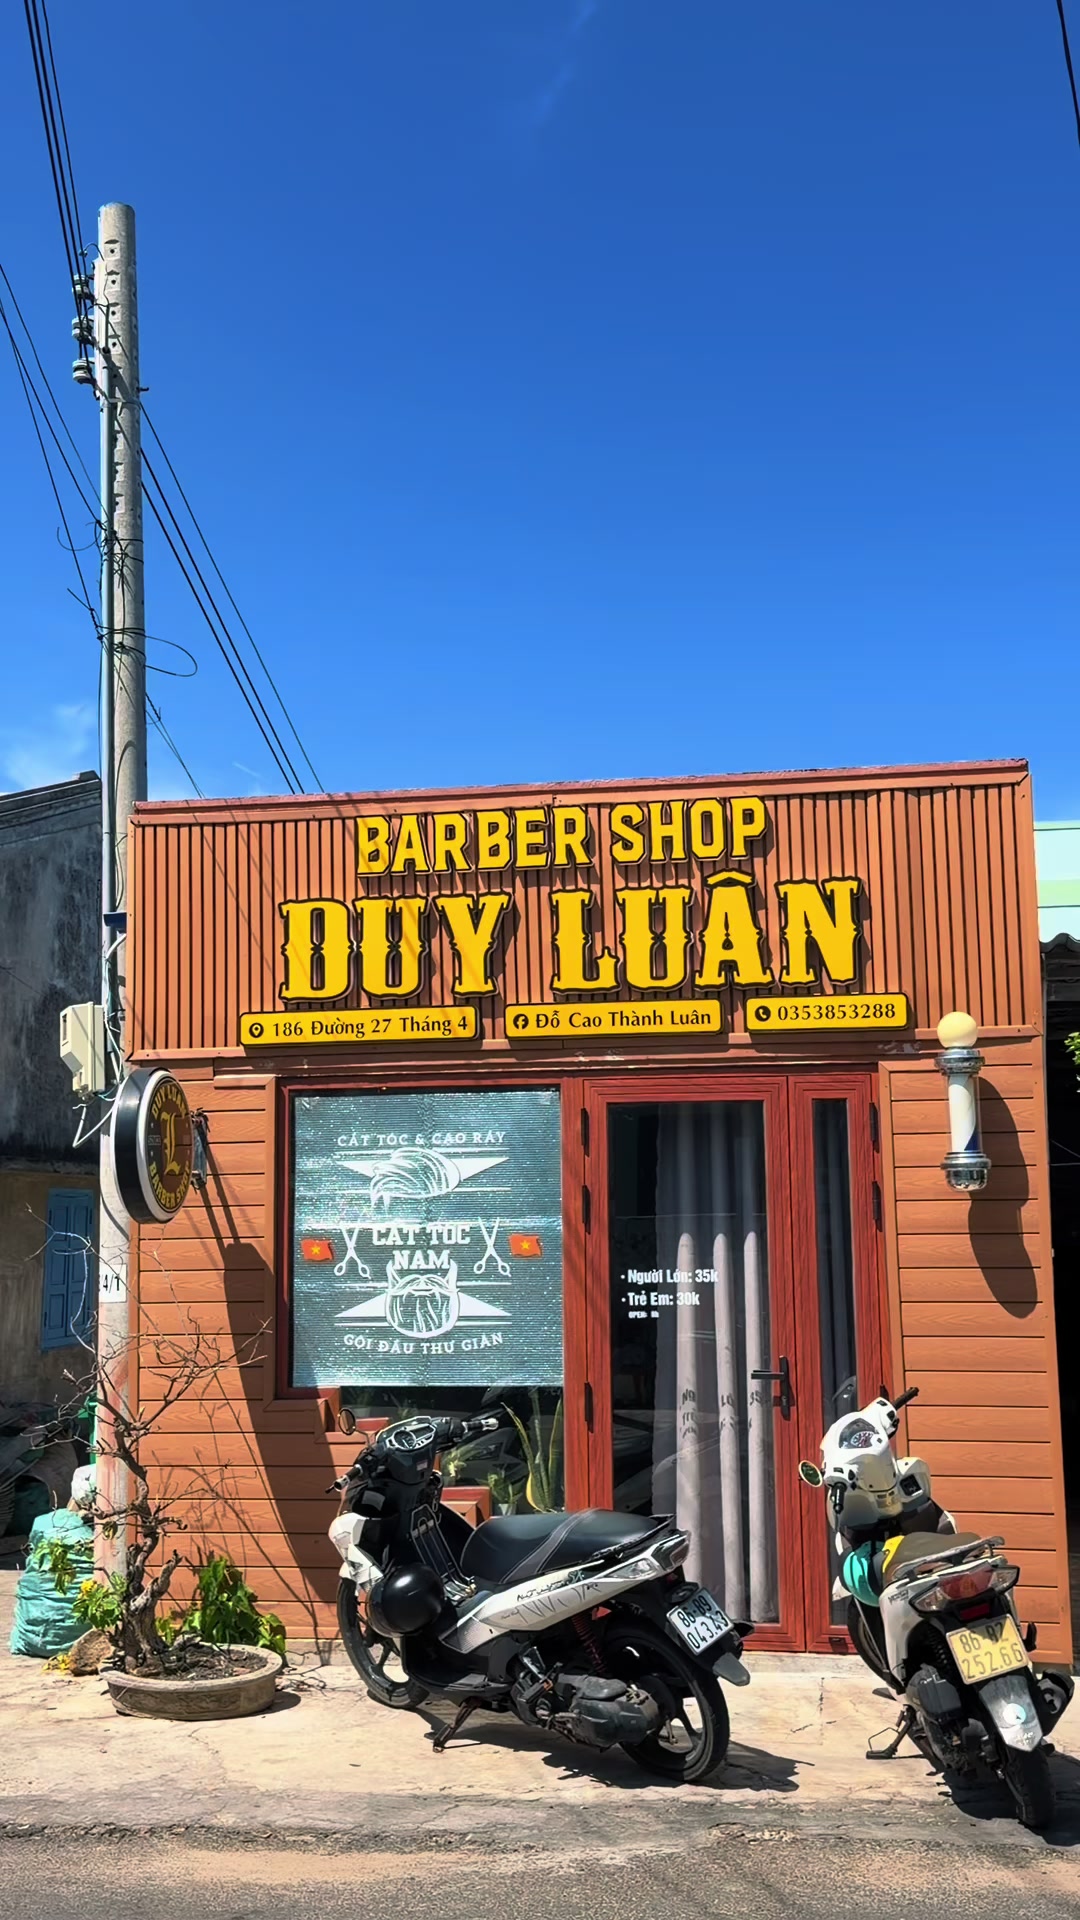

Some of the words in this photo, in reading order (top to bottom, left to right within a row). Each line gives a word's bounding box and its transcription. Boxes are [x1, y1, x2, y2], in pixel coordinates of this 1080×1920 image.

[355, 805, 594, 877] BARBER
[609, 796, 766, 864] SHOP
[278, 891, 512, 1001] DUY
[549, 868, 862, 993] LUÂN
[535, 1009, 561, 1029] Đỗ
[569, 1010, 602, 1028] Cao
[608, 1008, 666, 1027] Thành
[671, 1009, 711, 1026] Luân
[777, 1003, 896, 1021] 0353853288
[272, 1021, 303, 1037] 186
[311, 1018, 365, 1038] Đường
[371, 1018, 392, 1034] 27
[400, 1015, 451, 1036] Tháng
[457, 1015, 468, 1031] 4
[151, 1086, 166, 1120] DUY
[415, 1133, 425, 1146] &
[149, 1161, 176, 1208] BARBER
[392, 1249, 451, 1270] NAM
[627, 1269, 663, 1285] Người
[666, 1269, 693, 1283] Lớn:
[695, 1269, 719, 1283] 35k
[627, 1290, 647, 1306] Trẻ
[650, 1292, 674, 1306] Em:
[676, 1292, 700, 1306] 30k
[687, 1610, 729, 1649] 043.43
[961, 1642, 1024, 1679] 252.66
